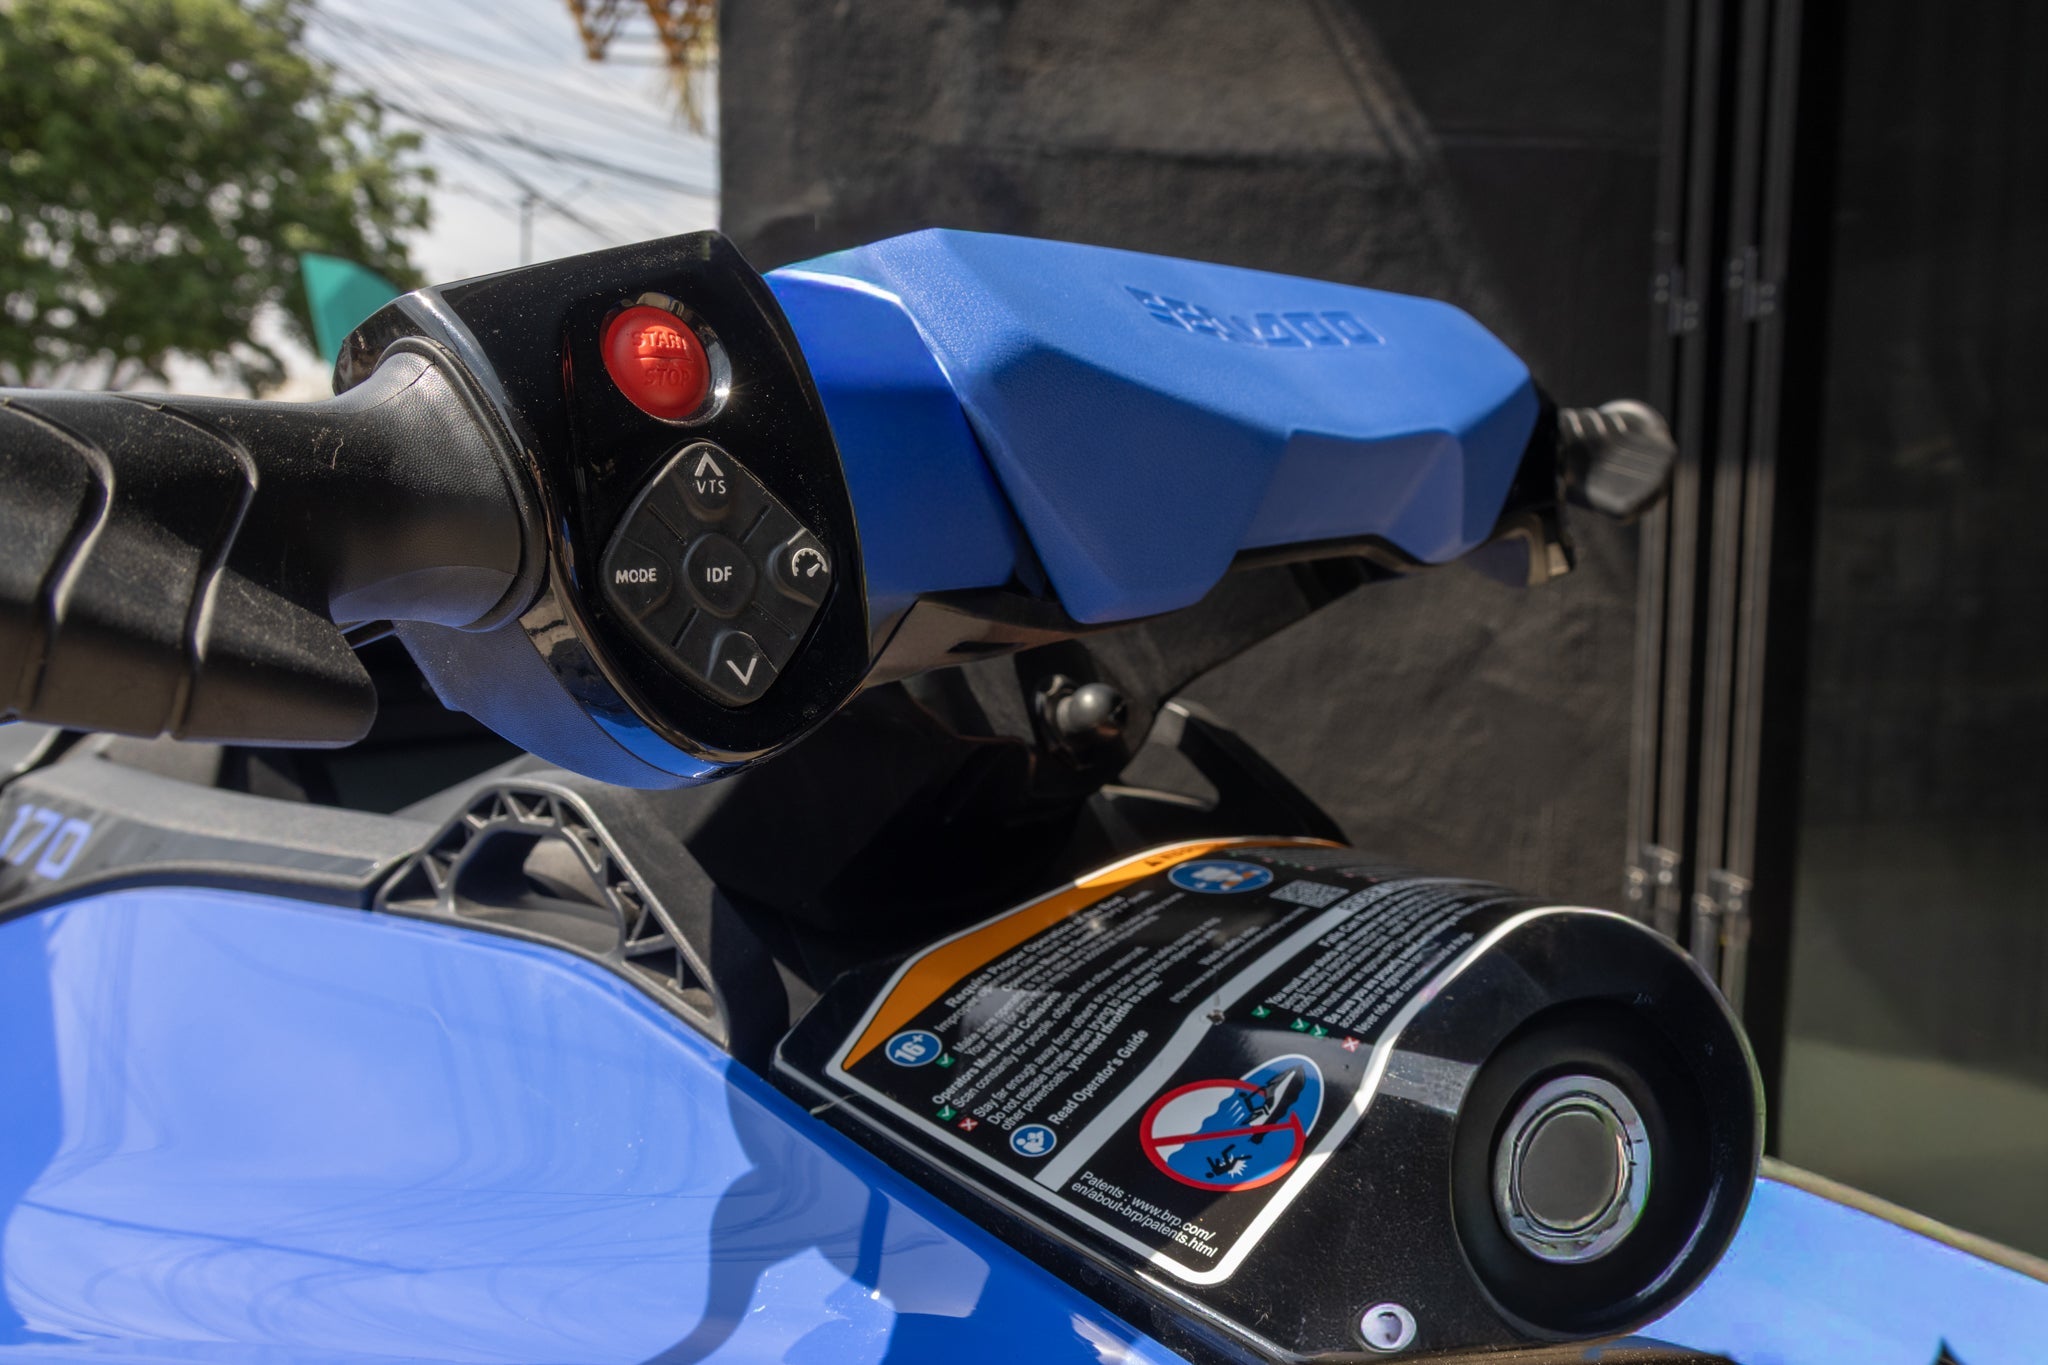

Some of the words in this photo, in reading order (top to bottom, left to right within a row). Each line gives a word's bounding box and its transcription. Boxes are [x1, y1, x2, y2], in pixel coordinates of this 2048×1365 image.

[632, 330, 687, 351] START
[644, 367, 691, 387] STOP
[695, 479, 727, 495] VTS
[615, 567, 658, 585] MODE
[706, 566, 733, 583] IDF
[0, 804, 92, 881] 170
[1265, 992, 1287, 1005] You
[1336, 999, 1356, 1014] sure
[952, 1032, 980, 1052] Make
[977, 1016, 998, 1033] sure
[964, 1039, 988, 1056] Your
[985, 1022, 1008, 1040] state
[1353, 1013, 1379, 1034] Never
[894, 1034, 926, 1062] 16+
[932, 1067, 979, 1103] Operators
[973, 1049, 1001, 1068] Must
[995, 1027, 1024, 1050] Avoid
[1018, 991, 1061, 1029] Collisions
[952, 1088, 979, 1108] Scan
[976, 1054, 1019, 1089] constantly
[1011, 1043, 1028, 1055] for
[1025, 1020, 1057, 1046] people,
[1052, 992, 1081, 1019] objects
[973, 1099, 999, 1117] Stay
[991, 1089, 1008, 1100] far
[1006, 1063, 1038, 1090] enough
[1034, 1044, 1060, 1065] away
[1052, 1027, 1076, 1046] from
[1072, 1003, 1098, 1028] others
[986, 1111, 1006, 1125] Do
[1002, 1098, 1020, 1113] not
[1016, 1074, 1048, 1100] release
[1042, 1050, 1074, 1075] throttle
[1069, 1029, 1093, 1050] when
[1087, 1006, 1117, 1030] trying
[1002, 1109, 1026, 1130] other
[1022, 1070, 1073, 1112] powerboats,
[1067, 1053, 1087, 1071] you
[1083, 1032, 1107, 1054] need
[1100, 1002, 1133, 1034] throttle
[1047, 1099, 1079, 1125] Read
[1072, 1058, 1124, 1102] Operator's
[1118, 1030, 1148, 1058] Guide
[1072, 1182, 1218, 1258] en/about-brp/patents.html
[1080, 1171, 1125, 1199] Patents
[1132, 1196, 1217, 1242] www.brp.com/
